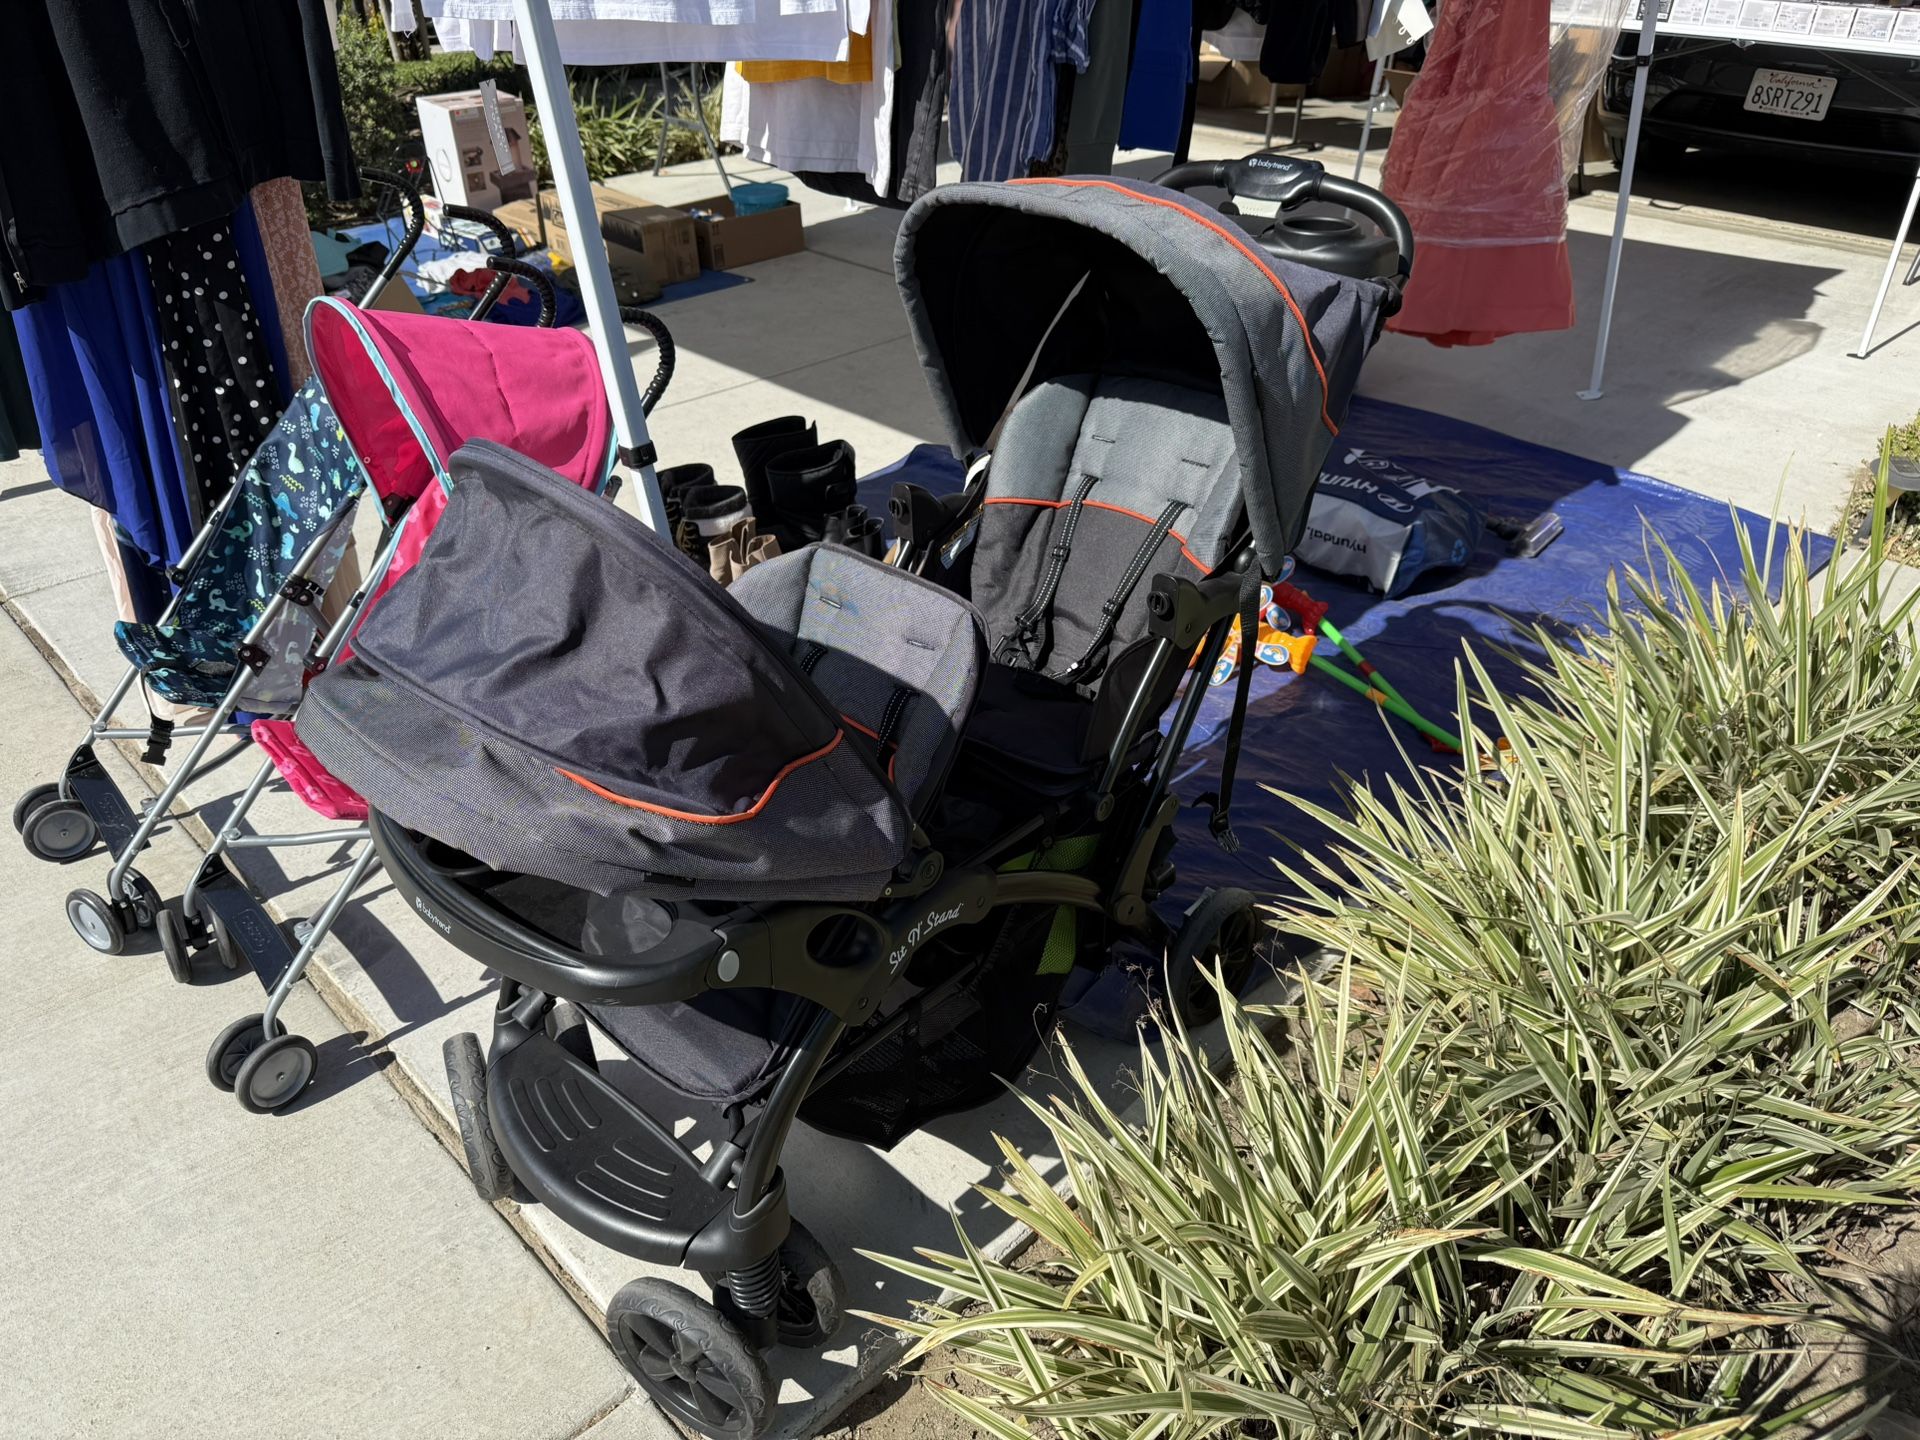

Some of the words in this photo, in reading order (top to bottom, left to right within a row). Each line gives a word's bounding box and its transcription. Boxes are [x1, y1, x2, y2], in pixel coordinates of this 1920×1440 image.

[1769, 74, 1819, 89] California
[1751, 84, 1823, 114] 8SRT291
[889, 945, 907, 975] Sit
[923, 902, 962, 935] Stand
